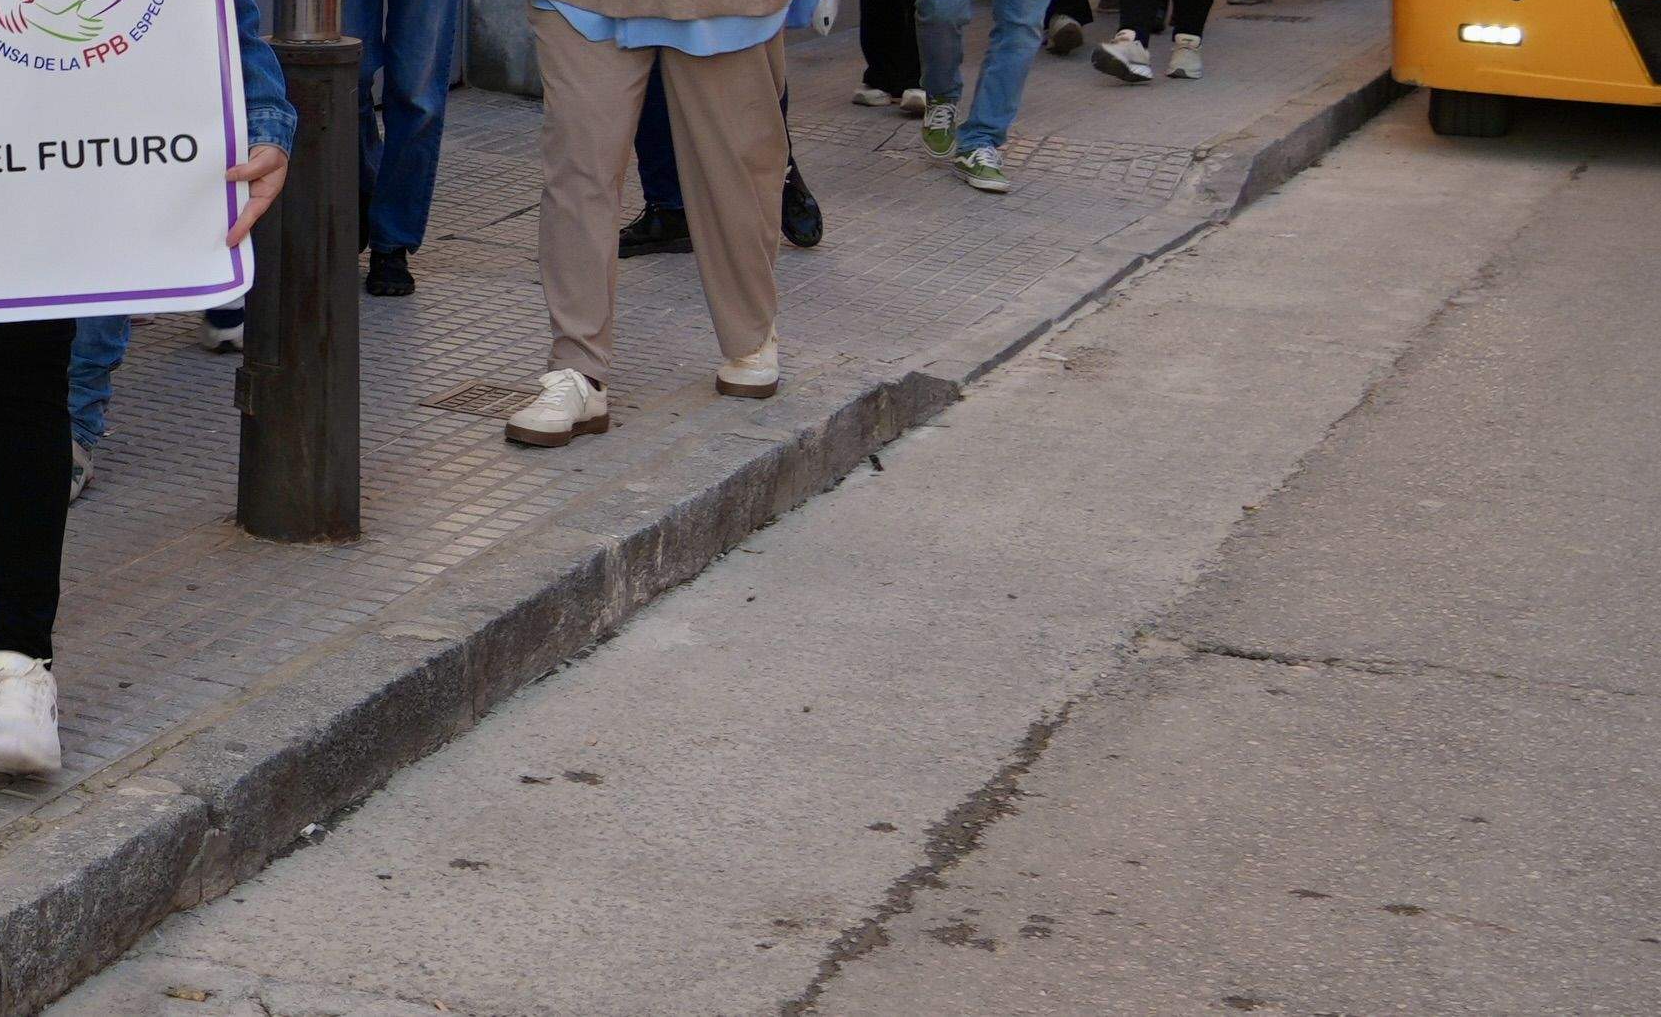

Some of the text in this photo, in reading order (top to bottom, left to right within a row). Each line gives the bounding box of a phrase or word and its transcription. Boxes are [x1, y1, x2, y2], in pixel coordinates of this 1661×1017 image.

[34, 56, 56, 71] DE
[60, 57, 81, 71] LA
[83, 34, 130, 68] FPB
[39, 133, 199, 171] FUTURO
